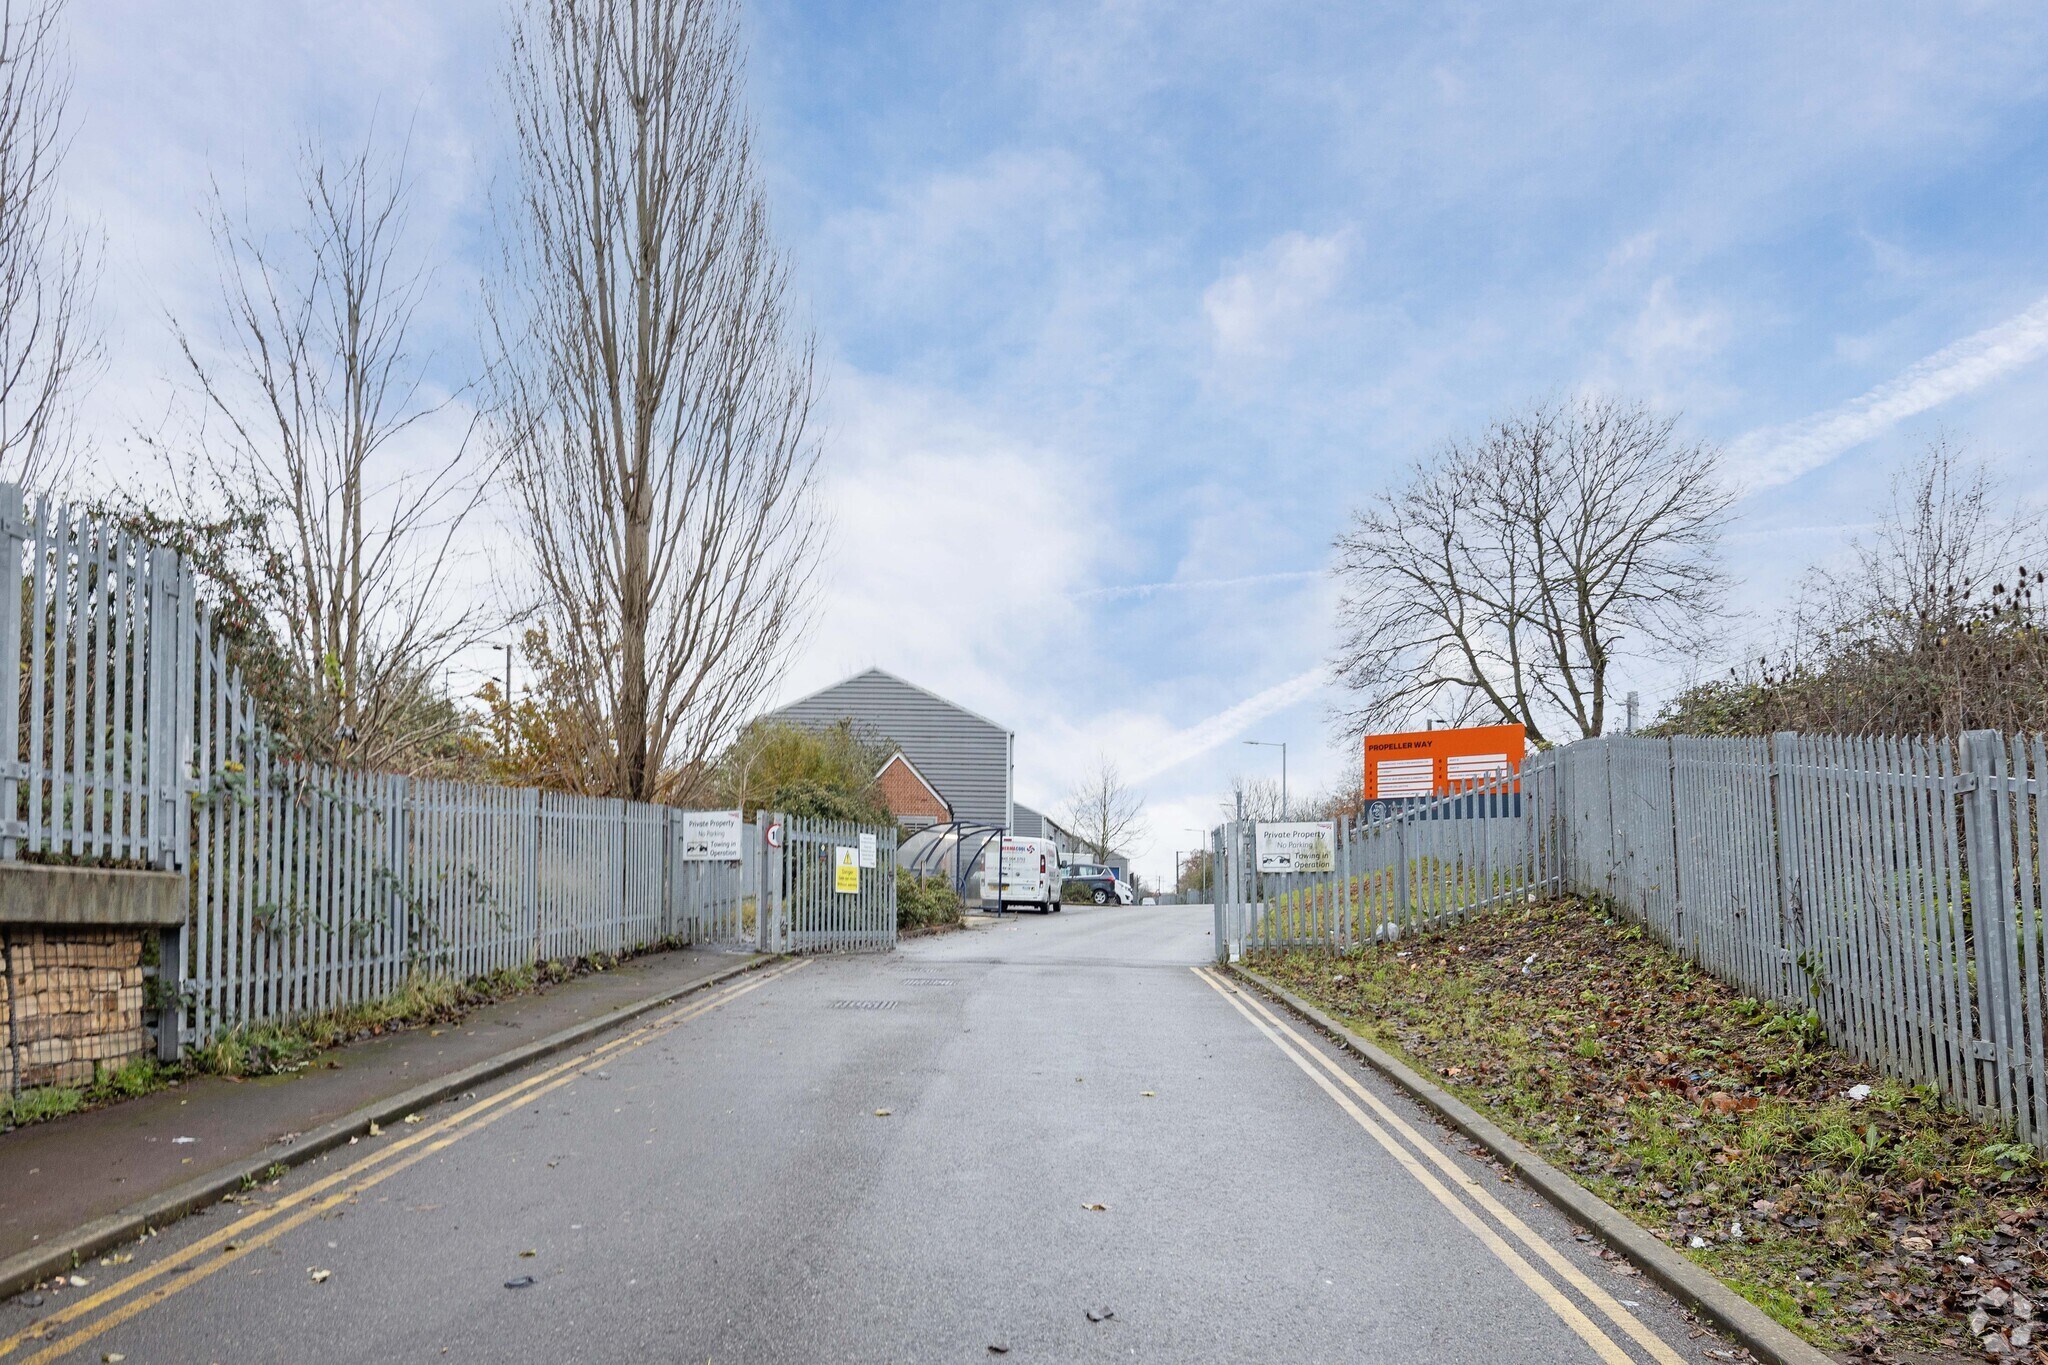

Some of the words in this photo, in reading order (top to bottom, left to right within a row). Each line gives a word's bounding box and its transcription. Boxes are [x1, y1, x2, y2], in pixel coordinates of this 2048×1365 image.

[1368, 742, 1412, 751] PROPELLER
[1414, 740, 1433, 748] WAY
[710, 820, 735, 828] Property
[1293, 831, 1326, 839] Property
[1295, 852, 1320, 860] Towing
